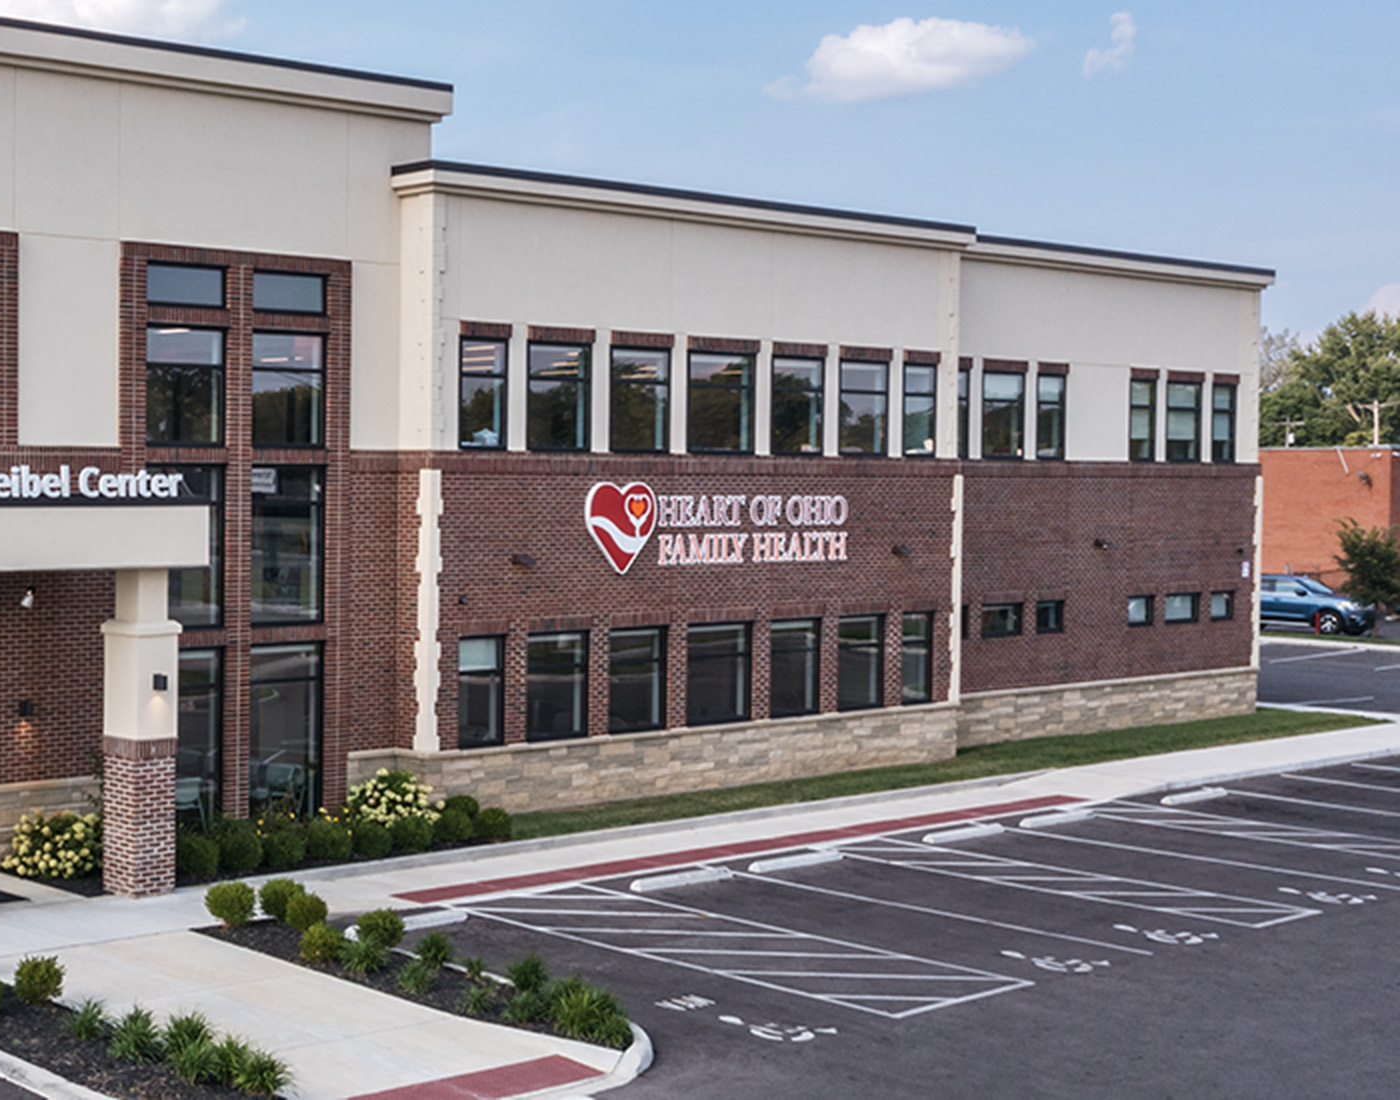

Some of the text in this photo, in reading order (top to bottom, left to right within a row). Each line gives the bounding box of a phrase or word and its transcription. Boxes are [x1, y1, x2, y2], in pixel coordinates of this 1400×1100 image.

[78, 466, 183, 498] Center
[657, 494, 849, 527] HEART OF OHIO
[657, 531, 848, 565] FAMILY HEALTH
